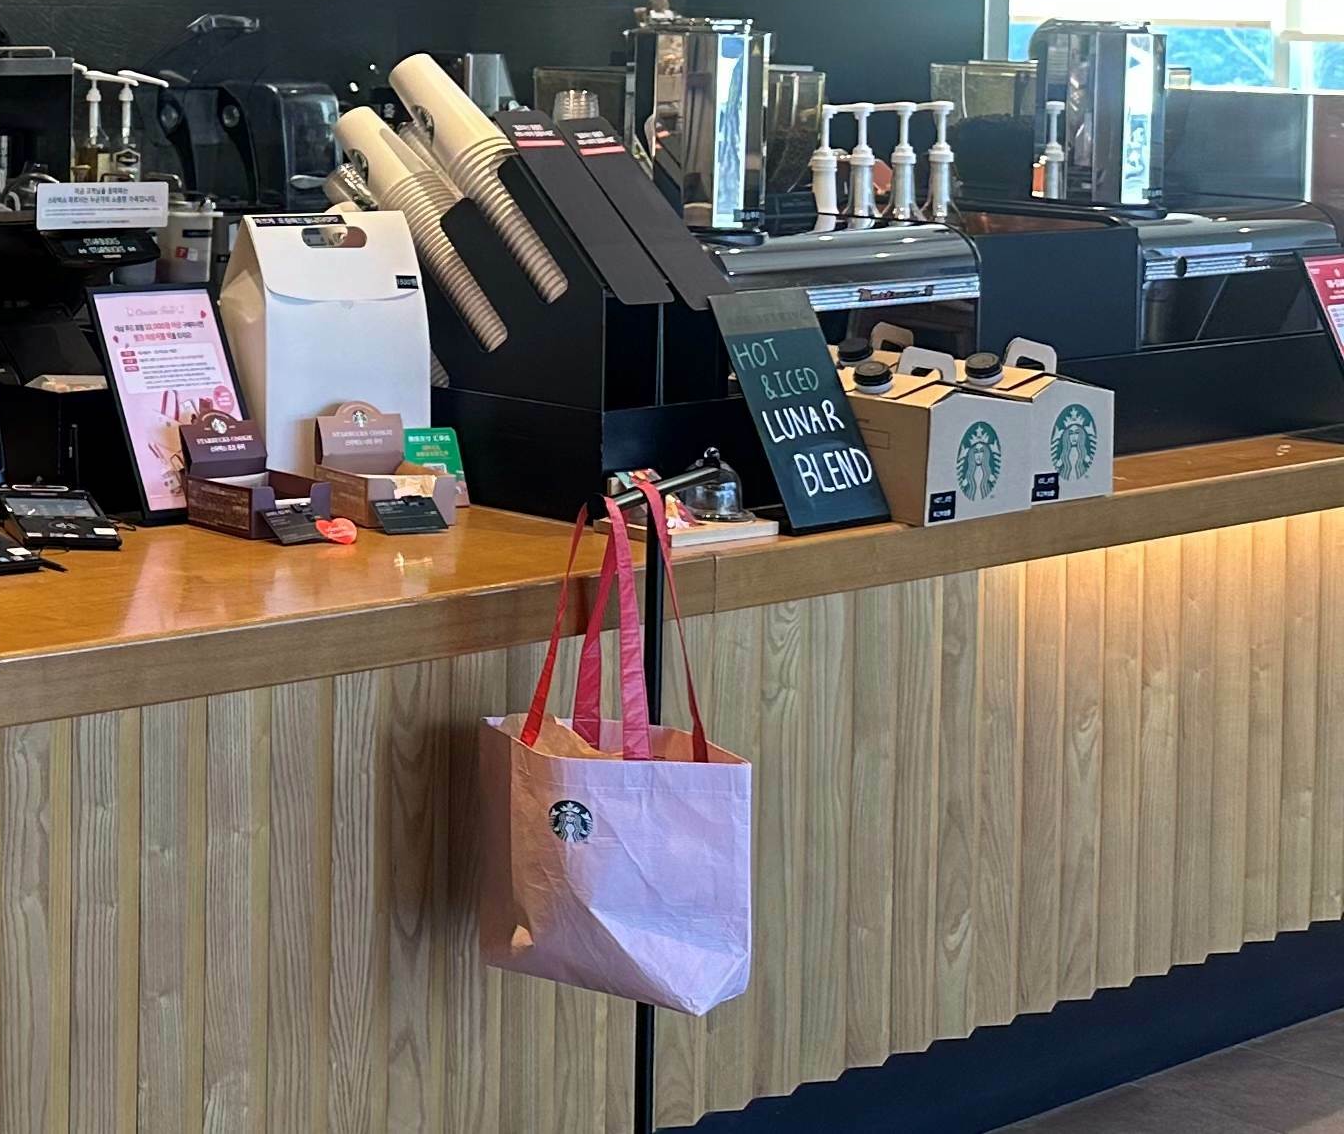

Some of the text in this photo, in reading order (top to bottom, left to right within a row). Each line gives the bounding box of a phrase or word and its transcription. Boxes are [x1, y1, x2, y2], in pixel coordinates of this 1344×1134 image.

[732, 338, 779, 370] HOT
[762, 399, 845, 443] LUNAR
[793, 447, 873, 497] BLEND
